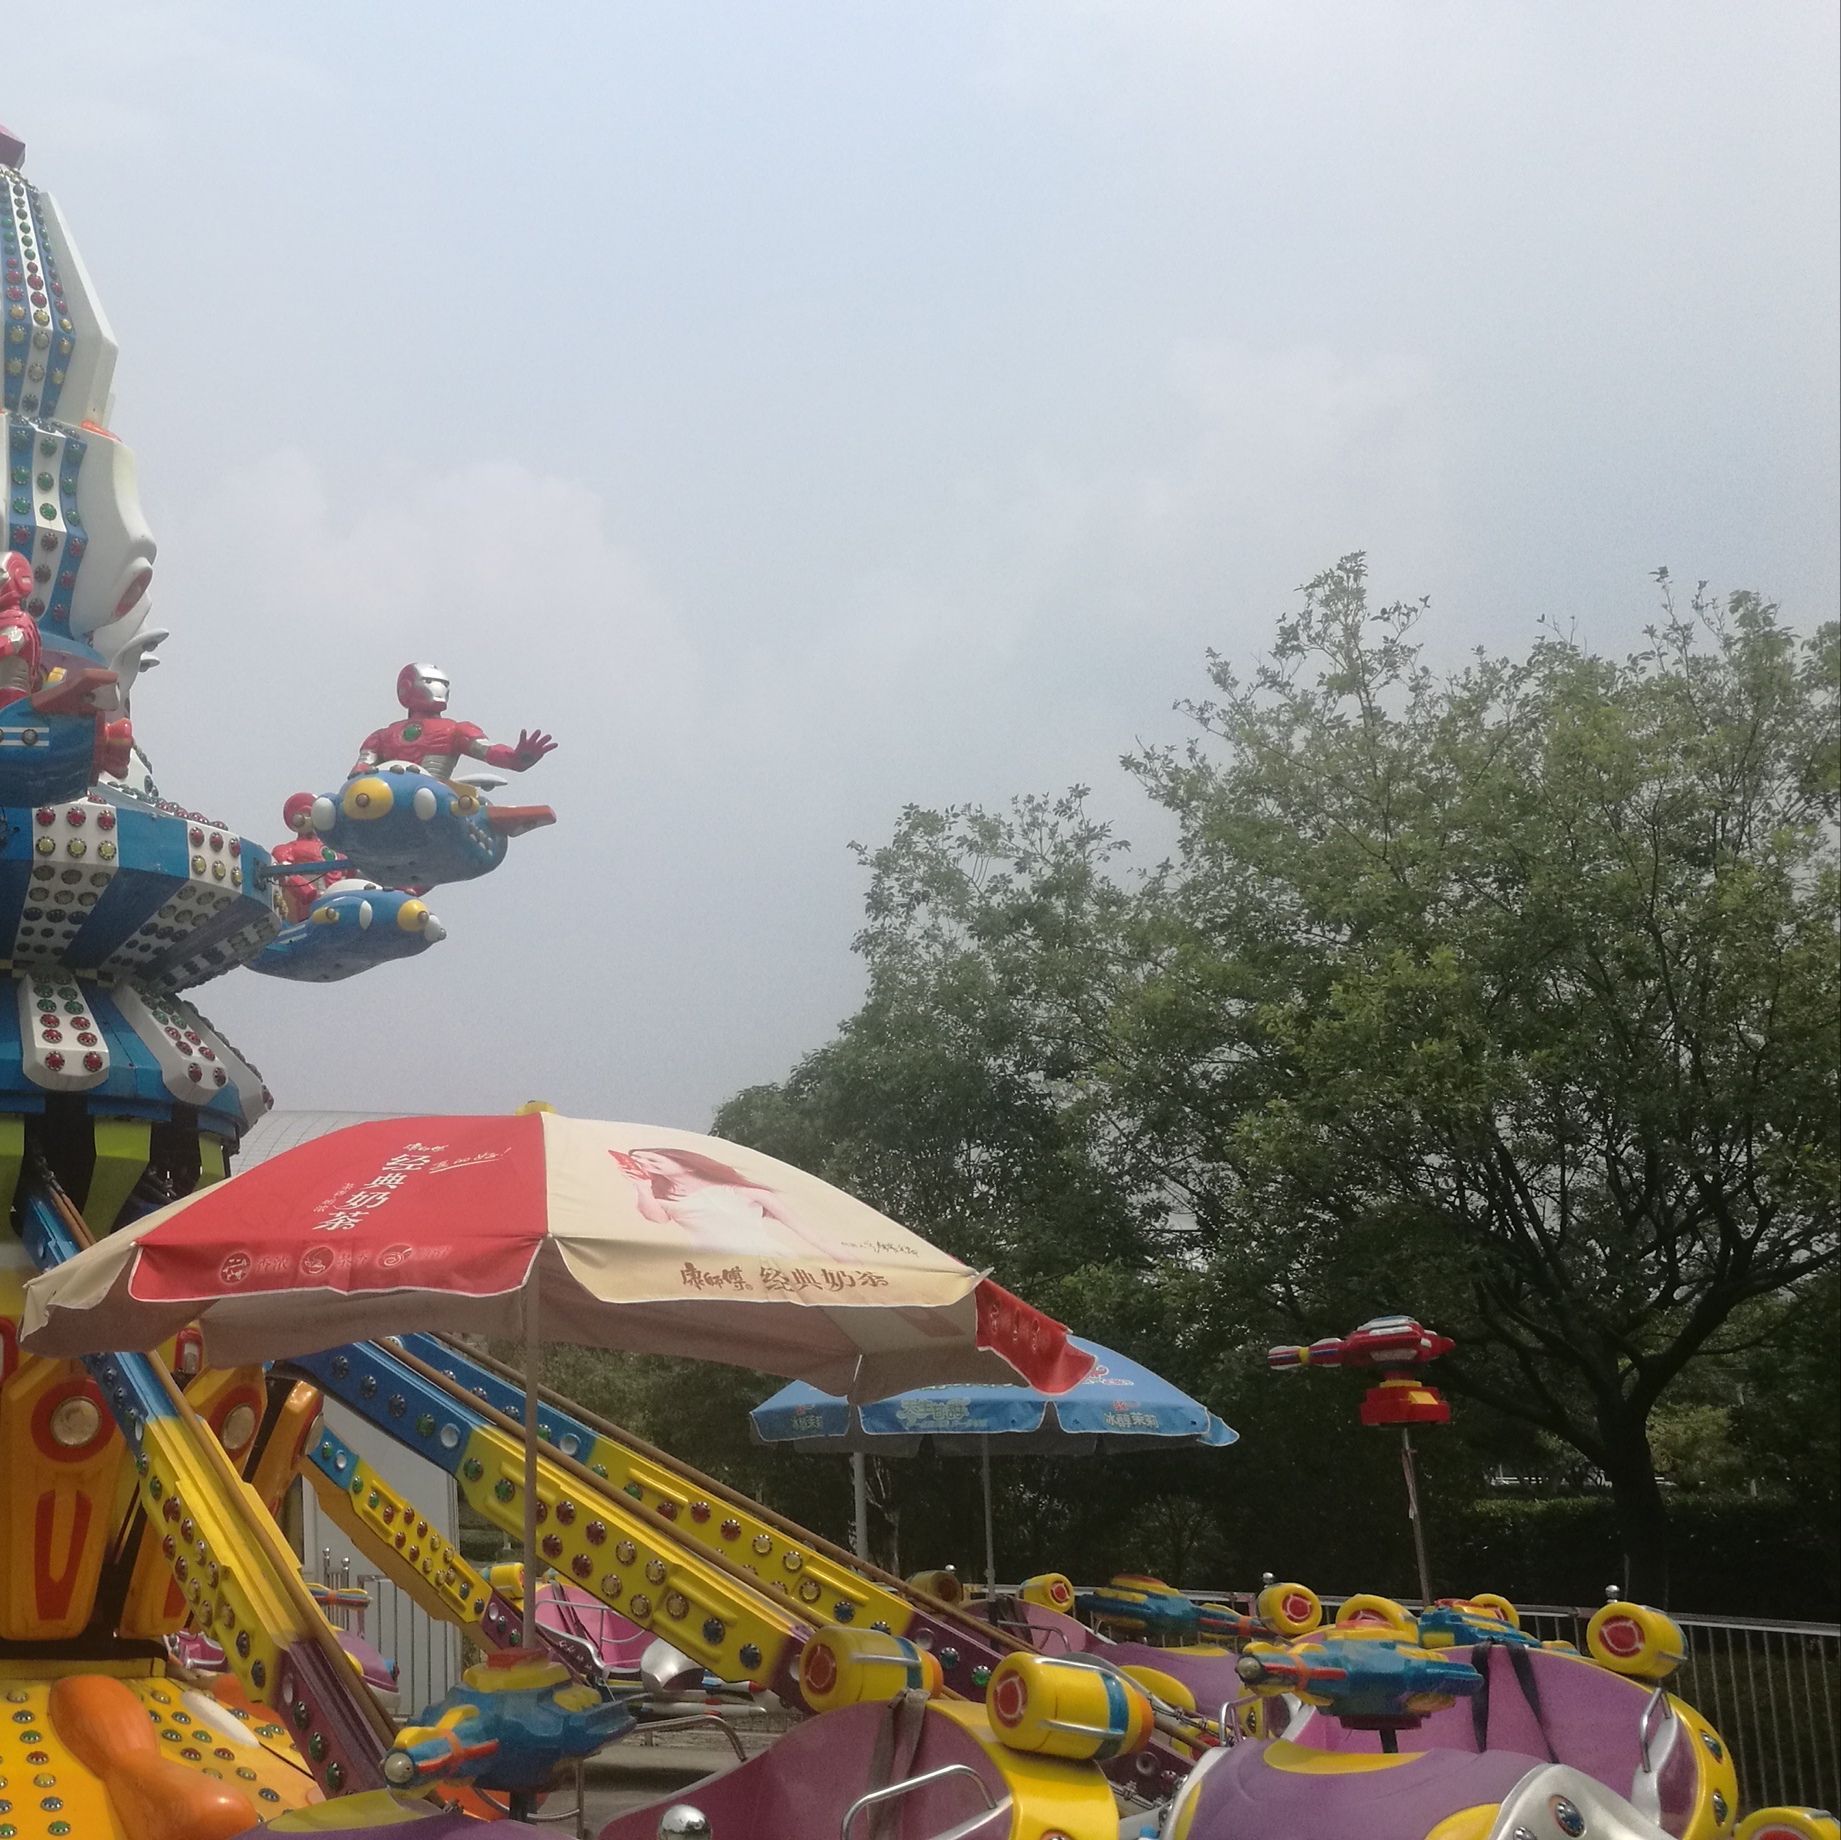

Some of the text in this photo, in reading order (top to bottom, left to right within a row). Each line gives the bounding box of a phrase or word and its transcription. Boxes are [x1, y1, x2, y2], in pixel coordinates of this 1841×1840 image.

[312, 1153, 432, 1231] 经典奶茶
[680, 1261, 889, 1292] 康师傅 经典奶茶
